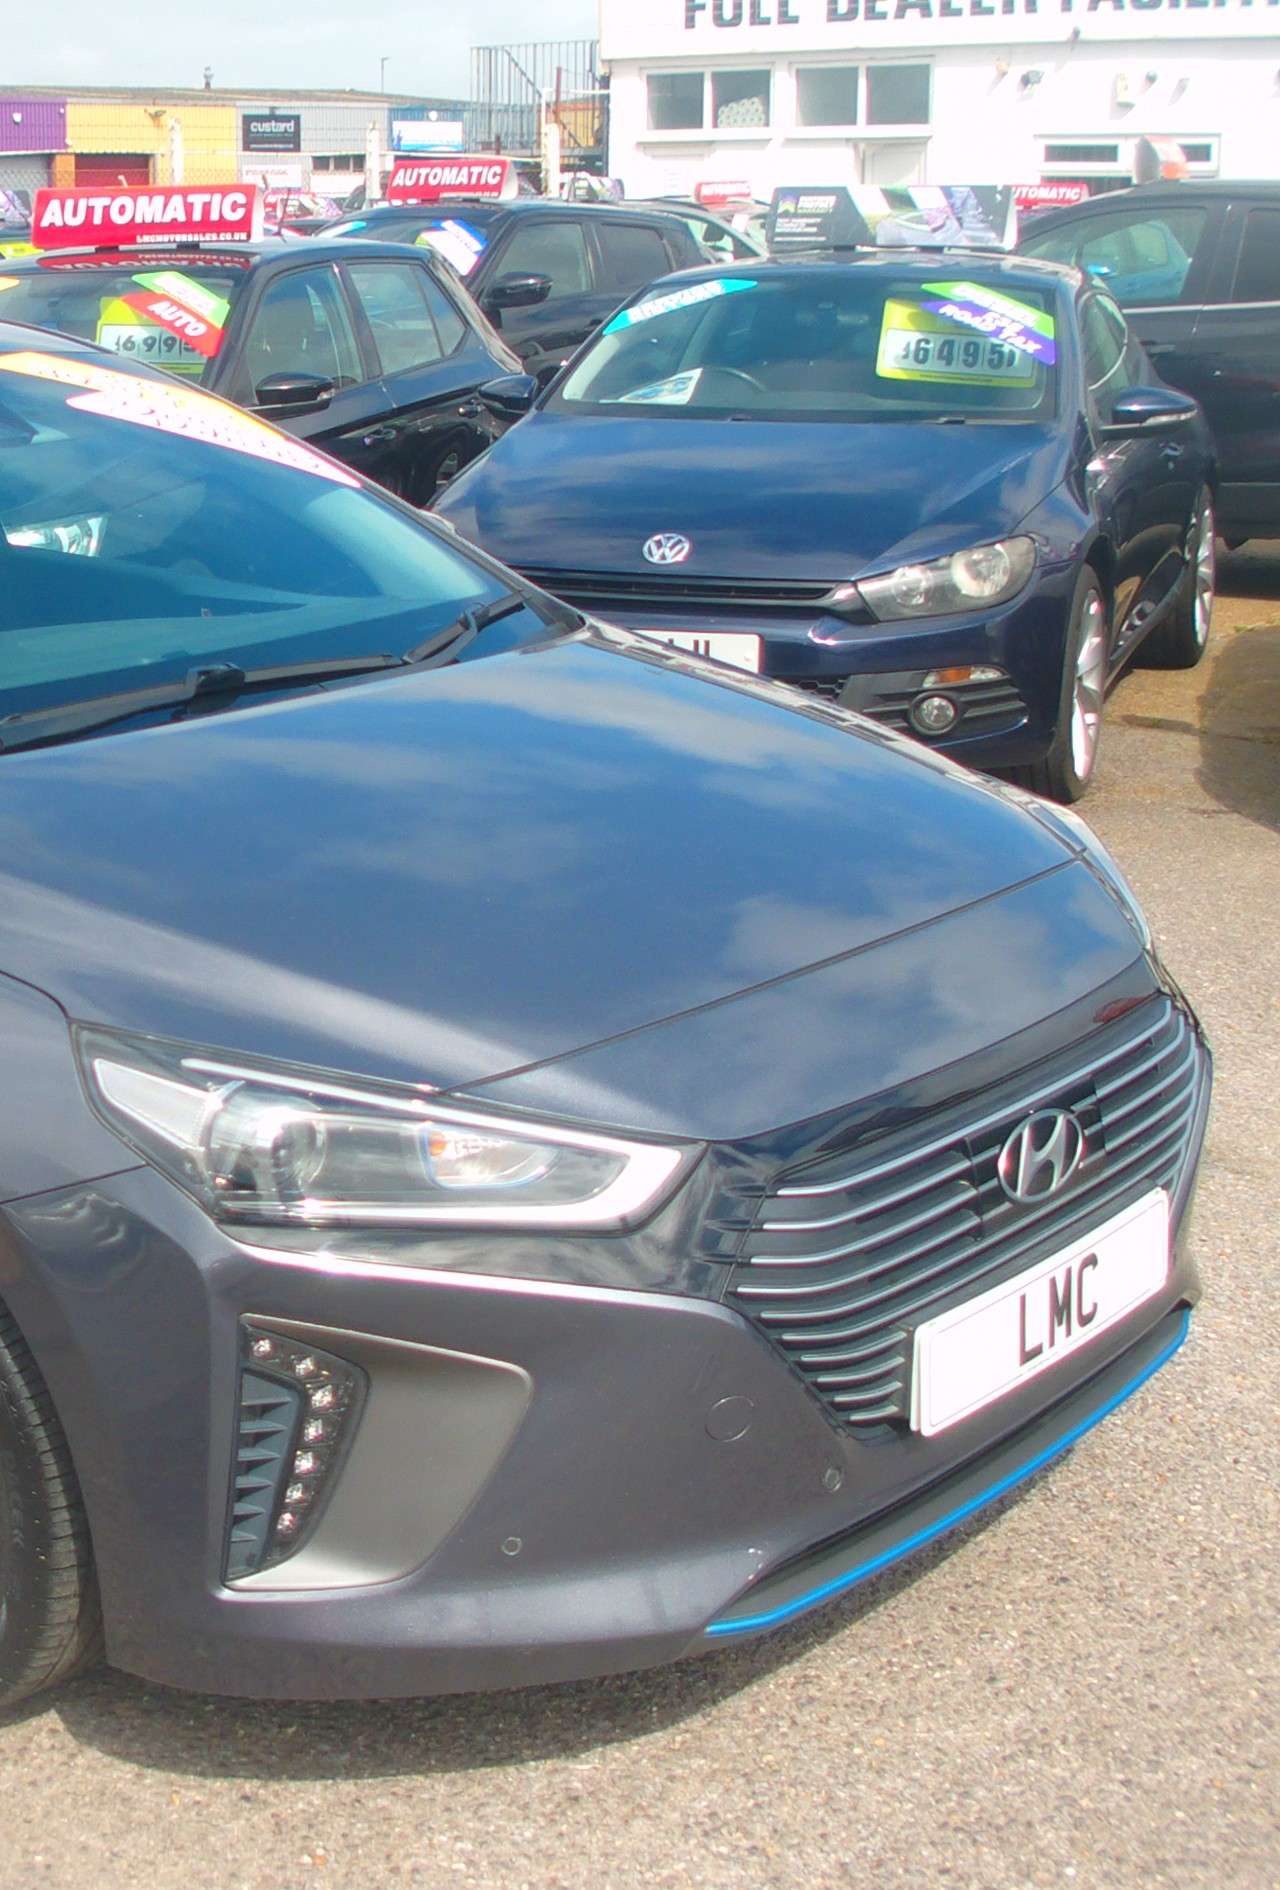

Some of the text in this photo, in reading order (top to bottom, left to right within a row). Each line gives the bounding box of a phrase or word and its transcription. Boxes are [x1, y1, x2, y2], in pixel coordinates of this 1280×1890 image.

[250, 119, 295, 133] custard
[391, 165, 502, 188] AUTOMATIC
[1011, 186, 1081, 200] UTOMATIC
[39, 191, 248, 228] AUTOMATIC
[147, 300, 207, 337] AUTO
[1018, 1252, 1099, 1368] LMC
